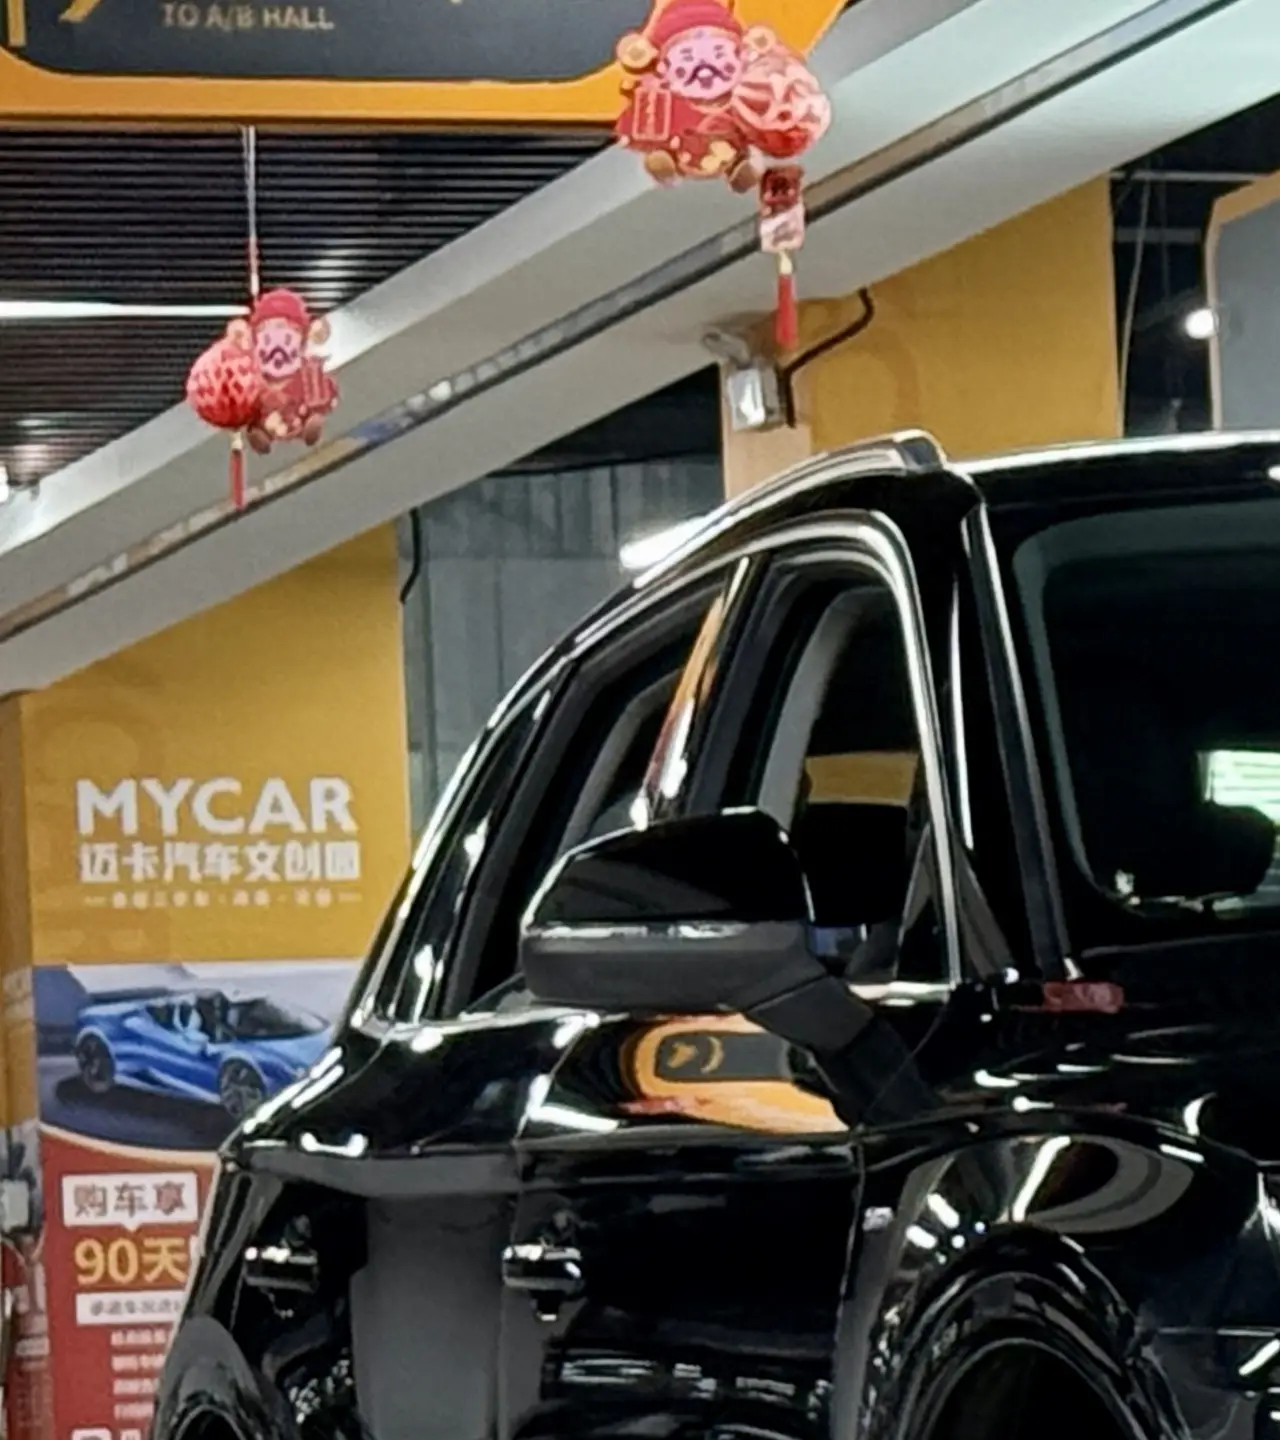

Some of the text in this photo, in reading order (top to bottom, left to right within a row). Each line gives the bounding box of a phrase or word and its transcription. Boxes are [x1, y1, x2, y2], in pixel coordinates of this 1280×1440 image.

[162, 3, 336, 32] TO A/B HALL
[75, 776, 360, 836] MYCAR
[73, 1181, 187, 1219] 购车享
[74, 1236, 198, 1286] 90天
